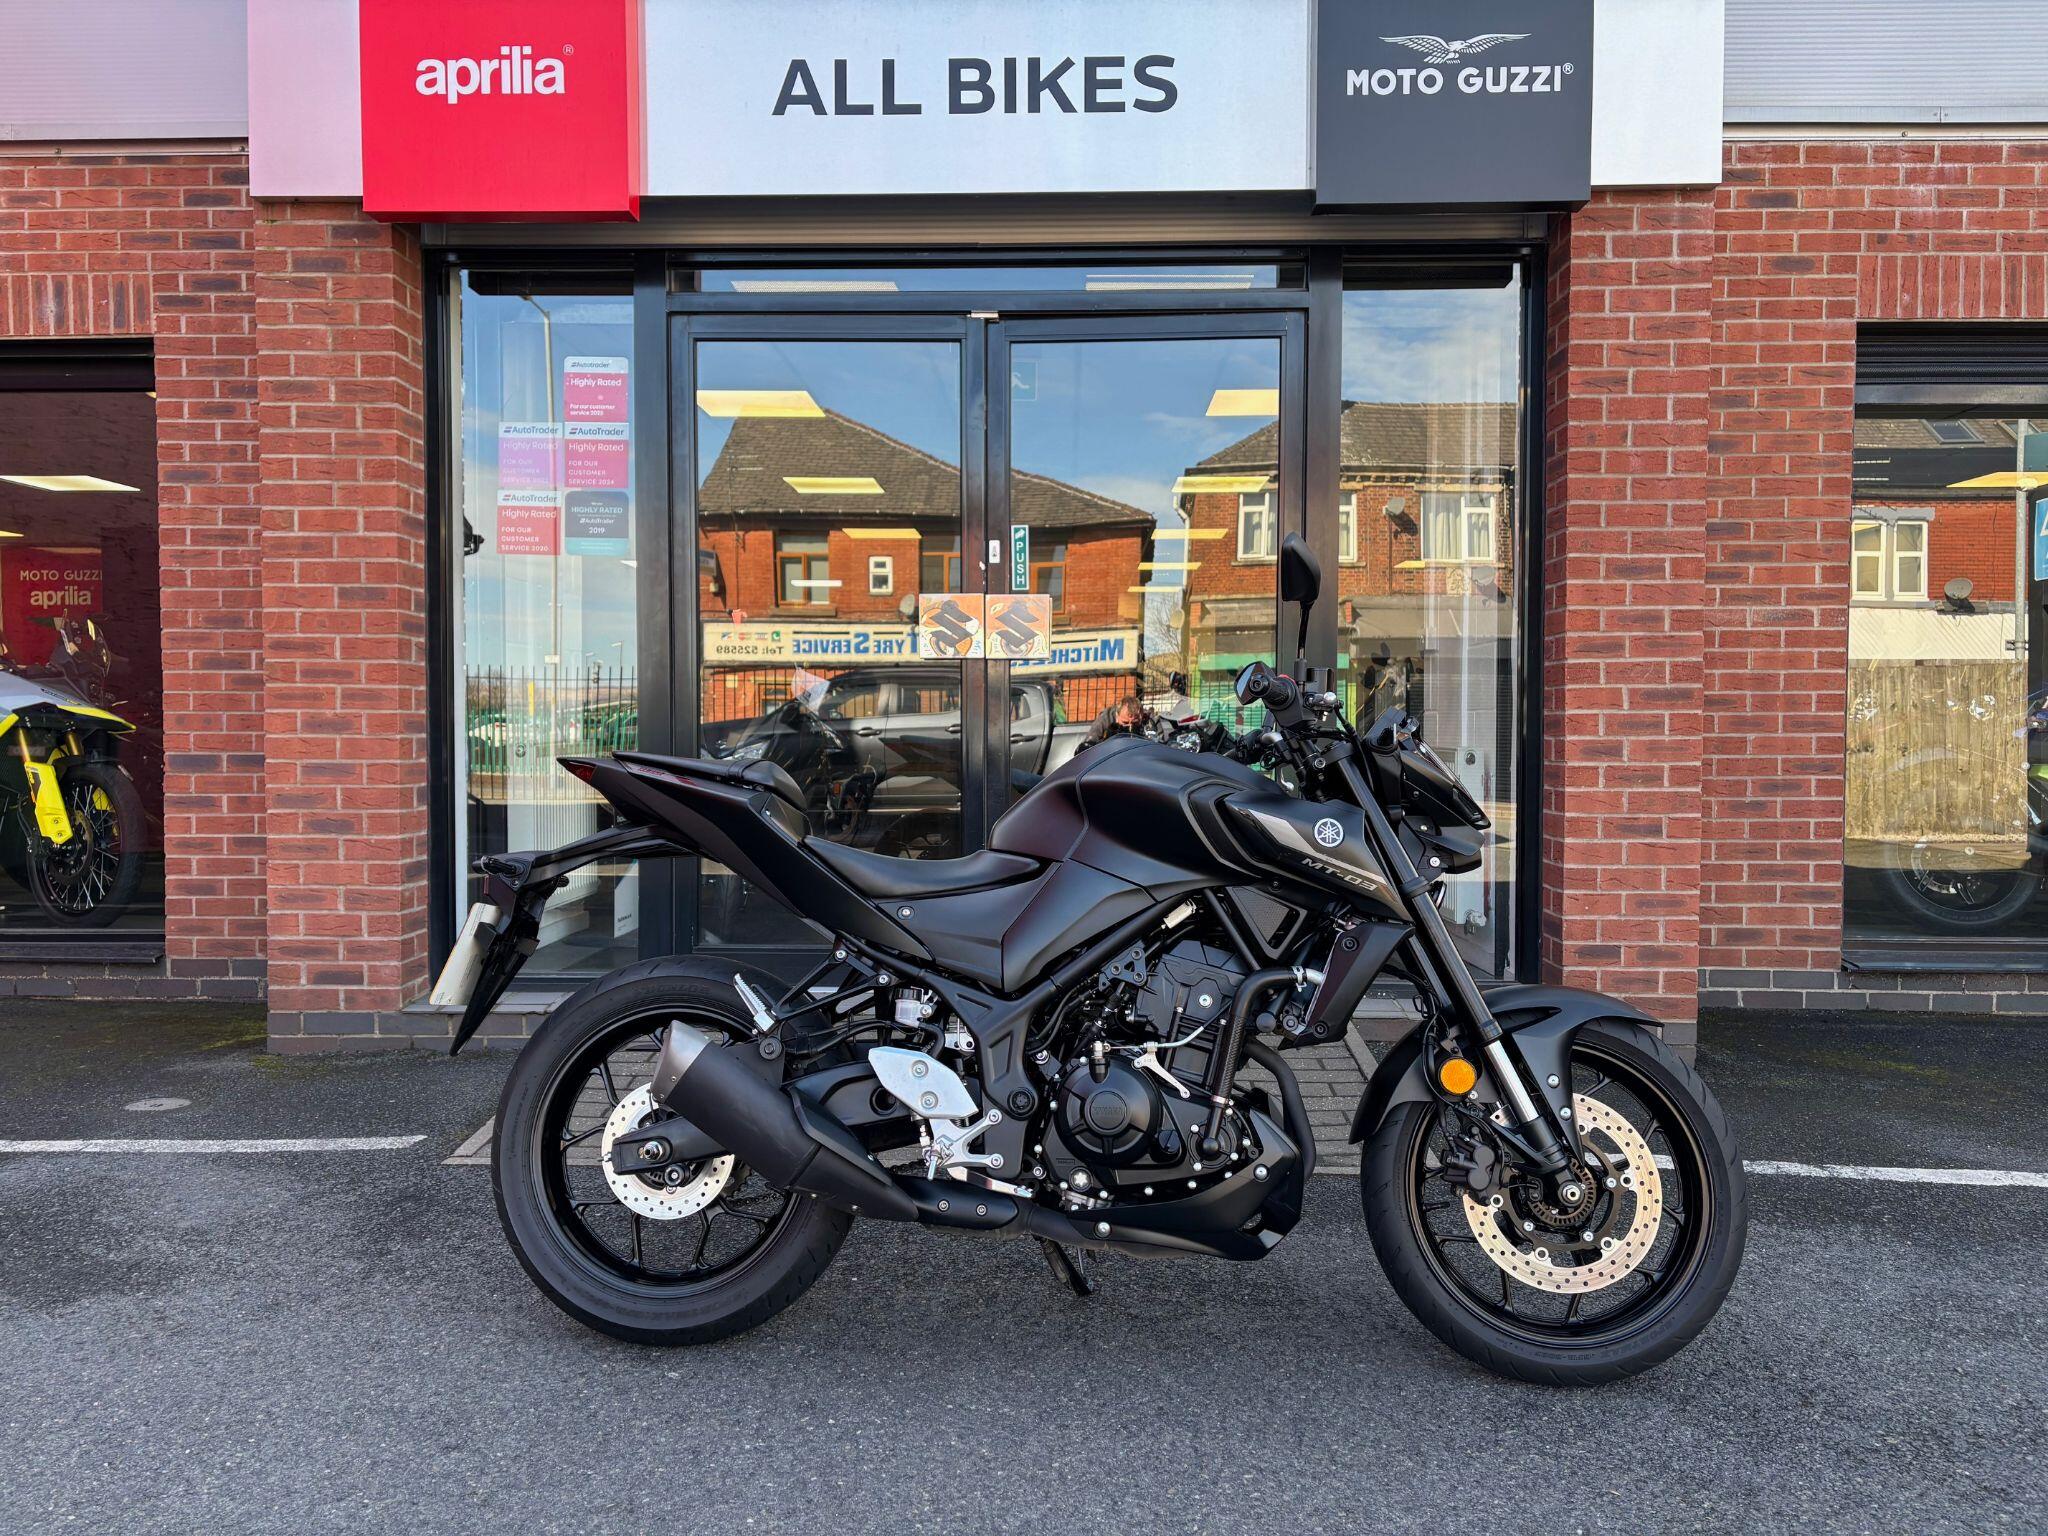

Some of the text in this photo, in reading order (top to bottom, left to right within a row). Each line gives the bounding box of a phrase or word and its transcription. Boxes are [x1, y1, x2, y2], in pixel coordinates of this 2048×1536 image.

[772, 54, 1178, 115] ALL BIKES
[1346, 67, 1444, 96] MOTO
[570, 377, 622, 388] Highly Rated
[512, 425, 559, 434] AutoTrader
[577, 427, 624, 436] AutoTrader
[503, 440, 530, 450] Highly
[568, 442, 624, 453] Highly Rated
[568, 478, 597, 486] SERVICE
[511, 494, 558, 503] AutoTrader
[502, 508, 557, 520] Highly Rated
[571, 506, 623, 514] HIGHLY RATED
[1015, 541, 1025, 585] PUSH
[20, 569, 60, 581] MOTO
[30, 585, 92, 609] aprilia
[1301, 857, 1378, 891] MT-03
